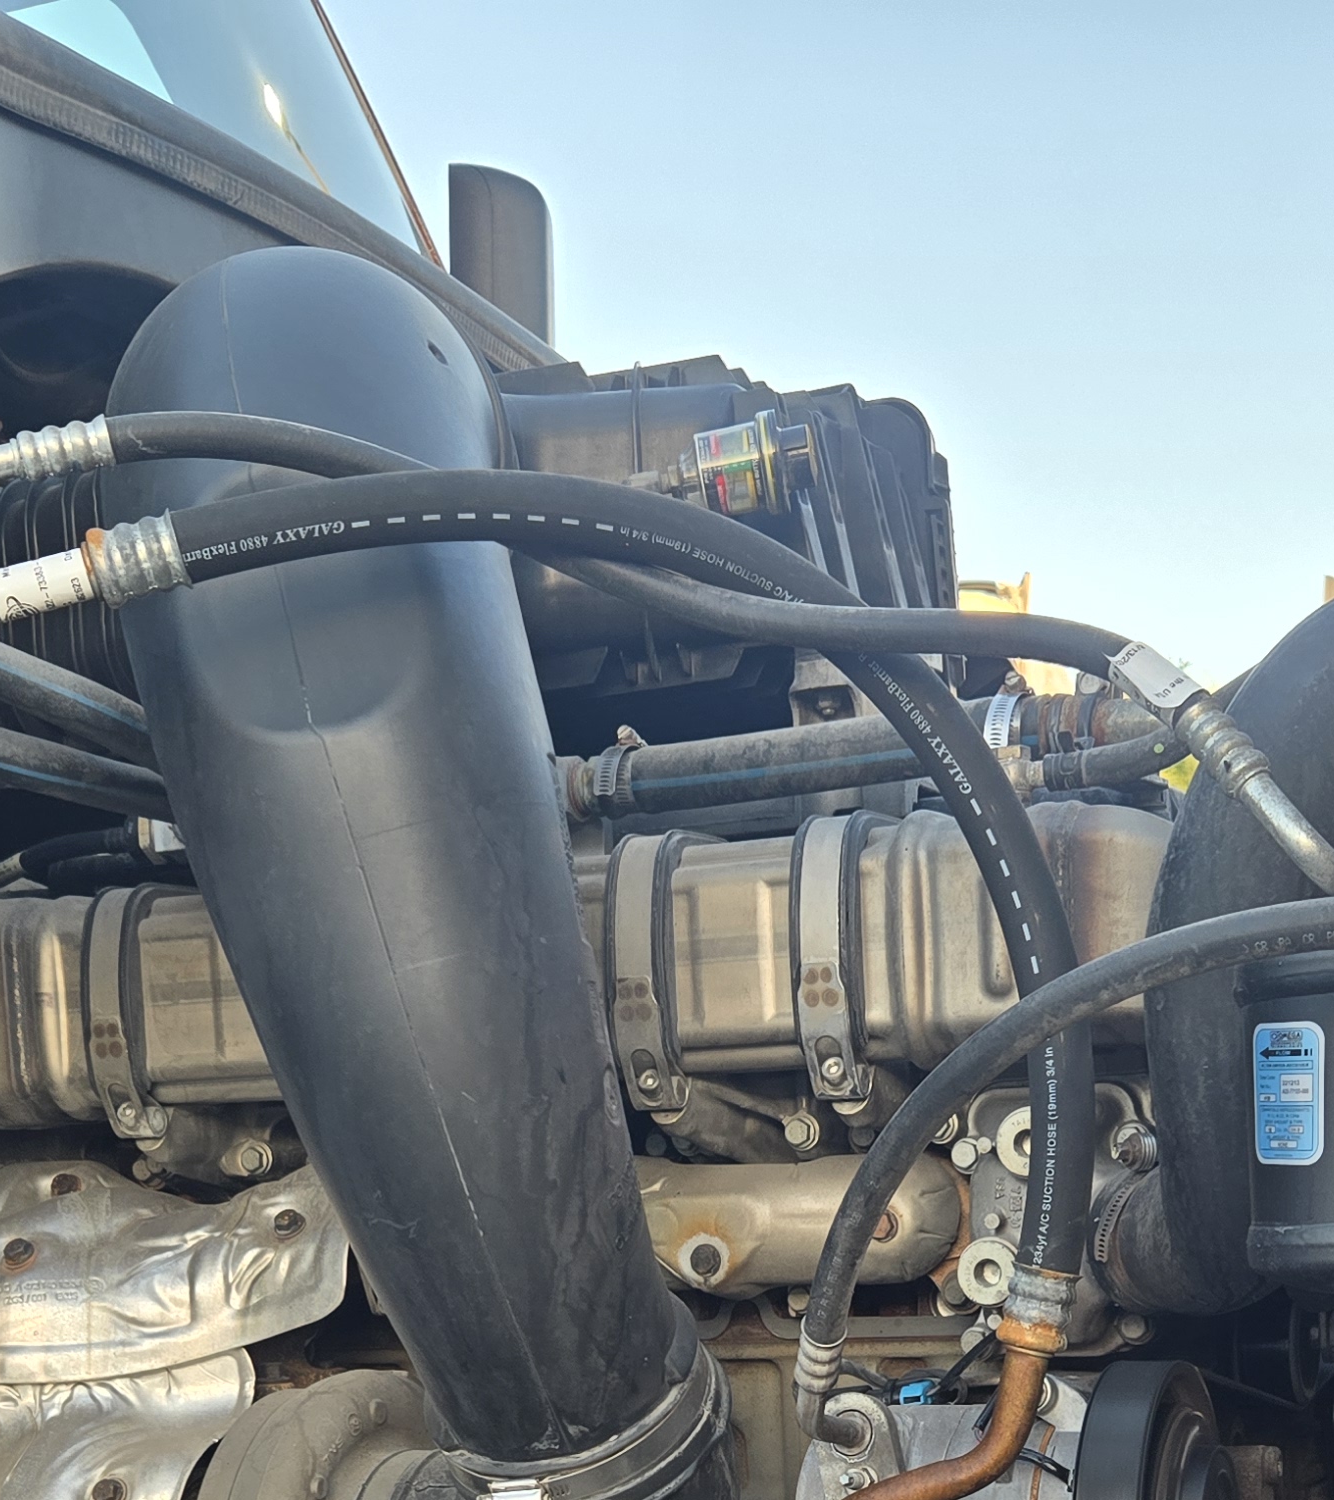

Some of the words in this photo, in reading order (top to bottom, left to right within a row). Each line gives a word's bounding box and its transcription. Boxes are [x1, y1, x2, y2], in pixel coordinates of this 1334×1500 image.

[239, 534, 269, 552] 4880
[273, 520, 345, 545] GALAXY
[631, 528, 649, 542] 3/4
[651, 533, 692, 554] (19mm)
[691, 546, 725, 567] HOSE
[725, 561, 774, 592] SUCTION
[868, 660, 915, 713] FlexBarrier
[909, 709, 932, 735] 4880
[927, 736, 973, 795] GALAXY
[1044, 1045, 1054, 1058] in
[1045, 1059, 1056, 1078] 3/4
[1047, 1078, 1058, 1120] (19mm)
[1046, 1122, 1057, 1157] HOSE
[1042, 1158, 1057, 1213] SUCTION
[1039, 1212, 1050, 1235] A/C
